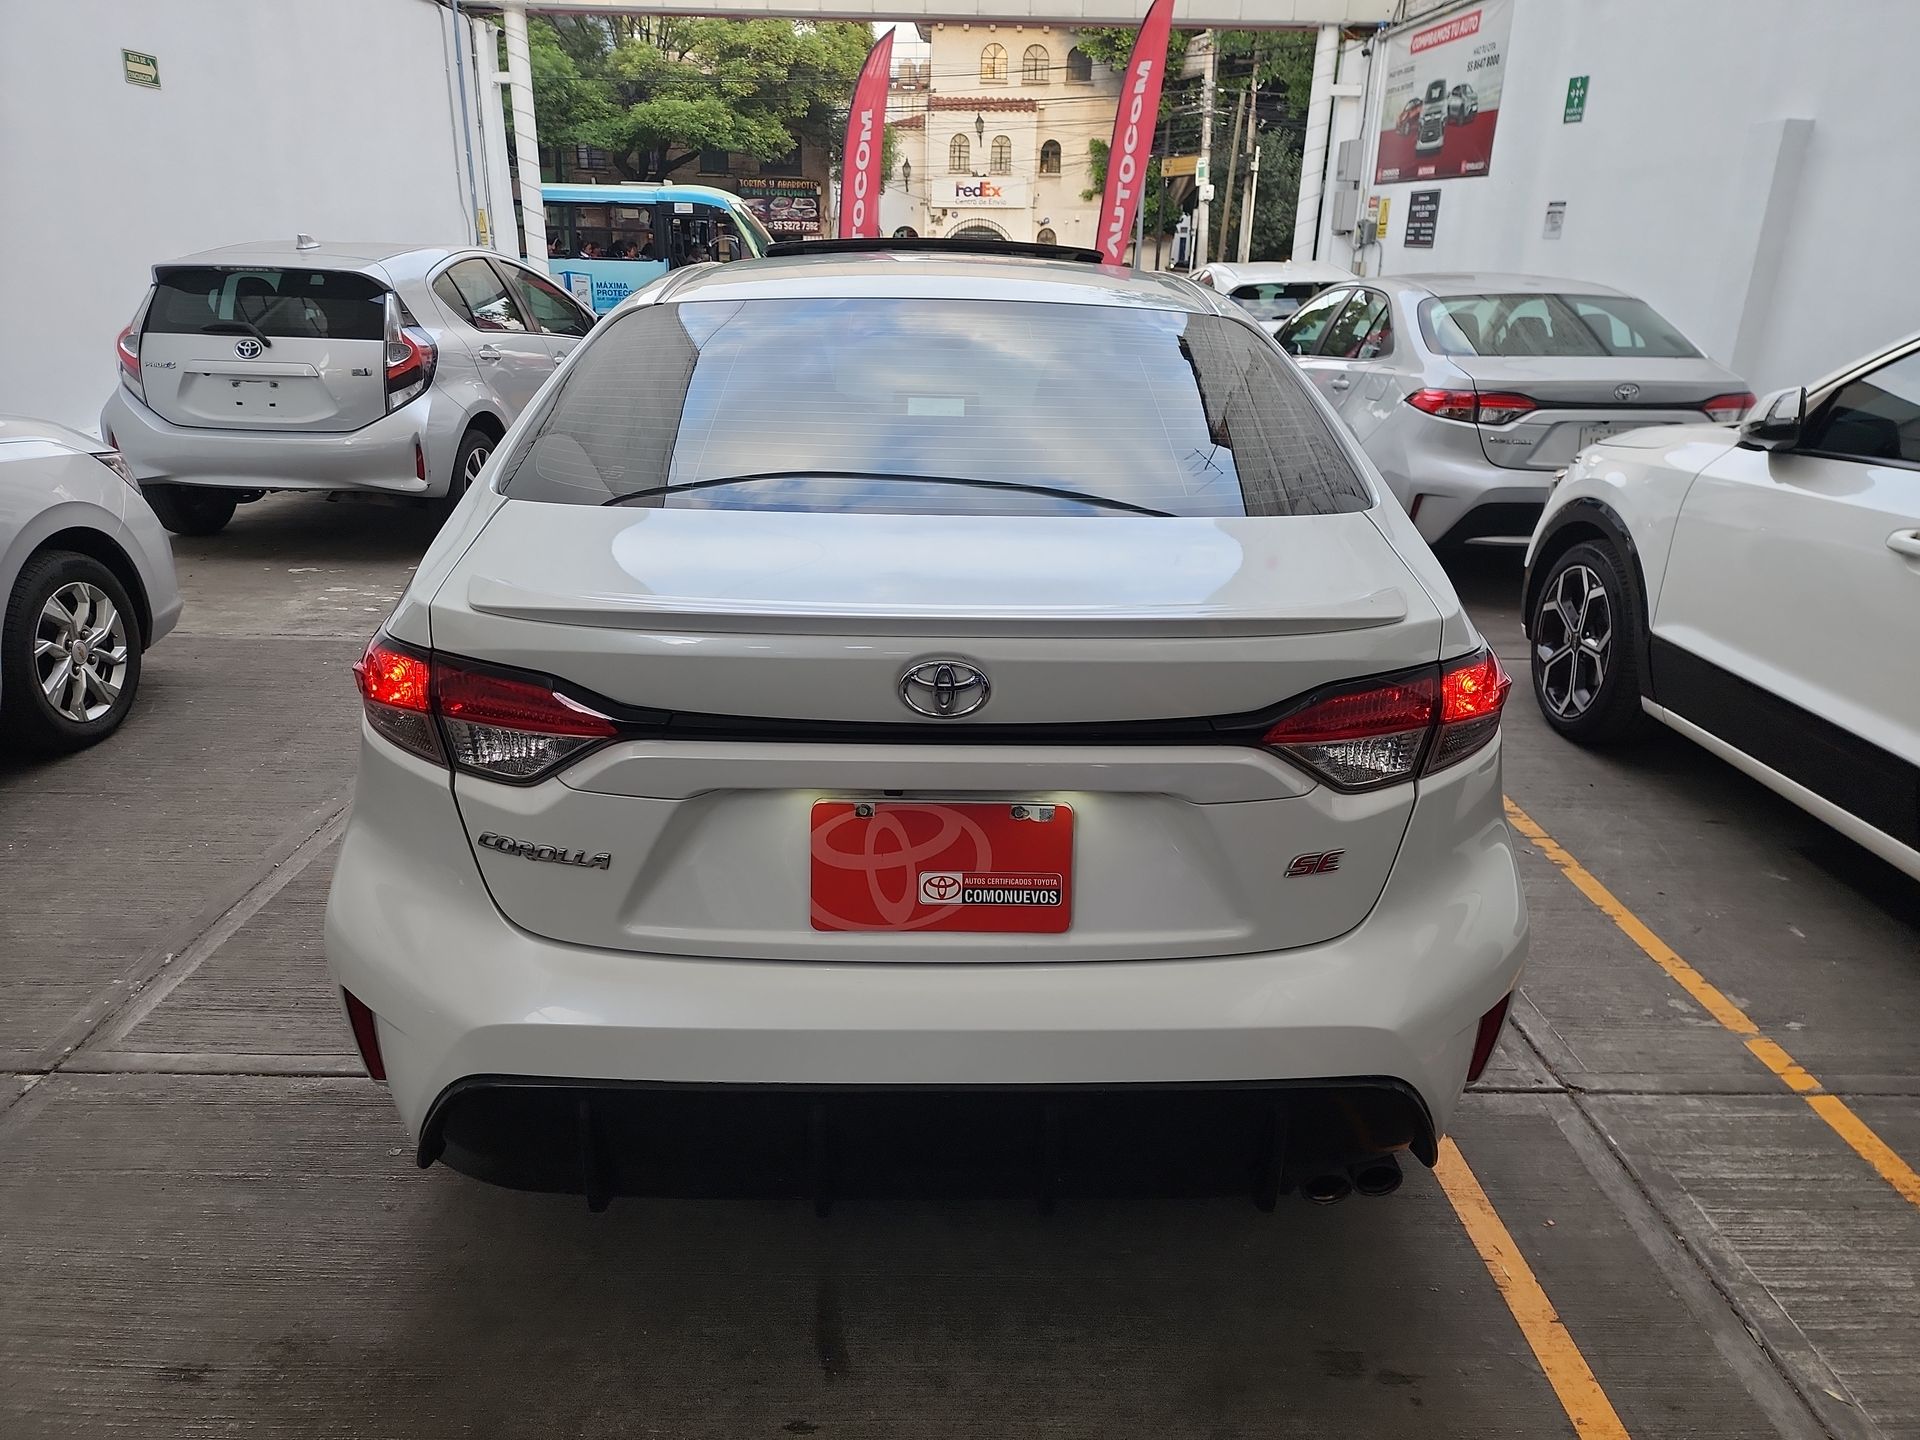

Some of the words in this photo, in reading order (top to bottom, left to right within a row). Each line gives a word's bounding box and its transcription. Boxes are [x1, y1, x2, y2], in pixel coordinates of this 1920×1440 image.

[1412, 24, 1451, 50] COMPRAMOS
[1461, 16, 1478, 35] AUTO
[1107, 60, 1153, 258] AUTOCOM
[740, 179, 767, 188] TORTAS
[777, 181, 819, 189] ABARROTES
[955, 181, 1001, 197] FedEx
[773, 221, 783, 230] 55
[596, 280, 629, 289] MÁXIMA
[478, 831, 611, 870] COROLLA
[1284, 848, 1346, 878] SE
[964, 877, 986, 885] AUTOS
[987, 877, 1032, 885] CERTIFICADOS
[1034, 878, 1058, 886] TOYOTA
[964, 889, 1058, 904] COMONUEVOS
